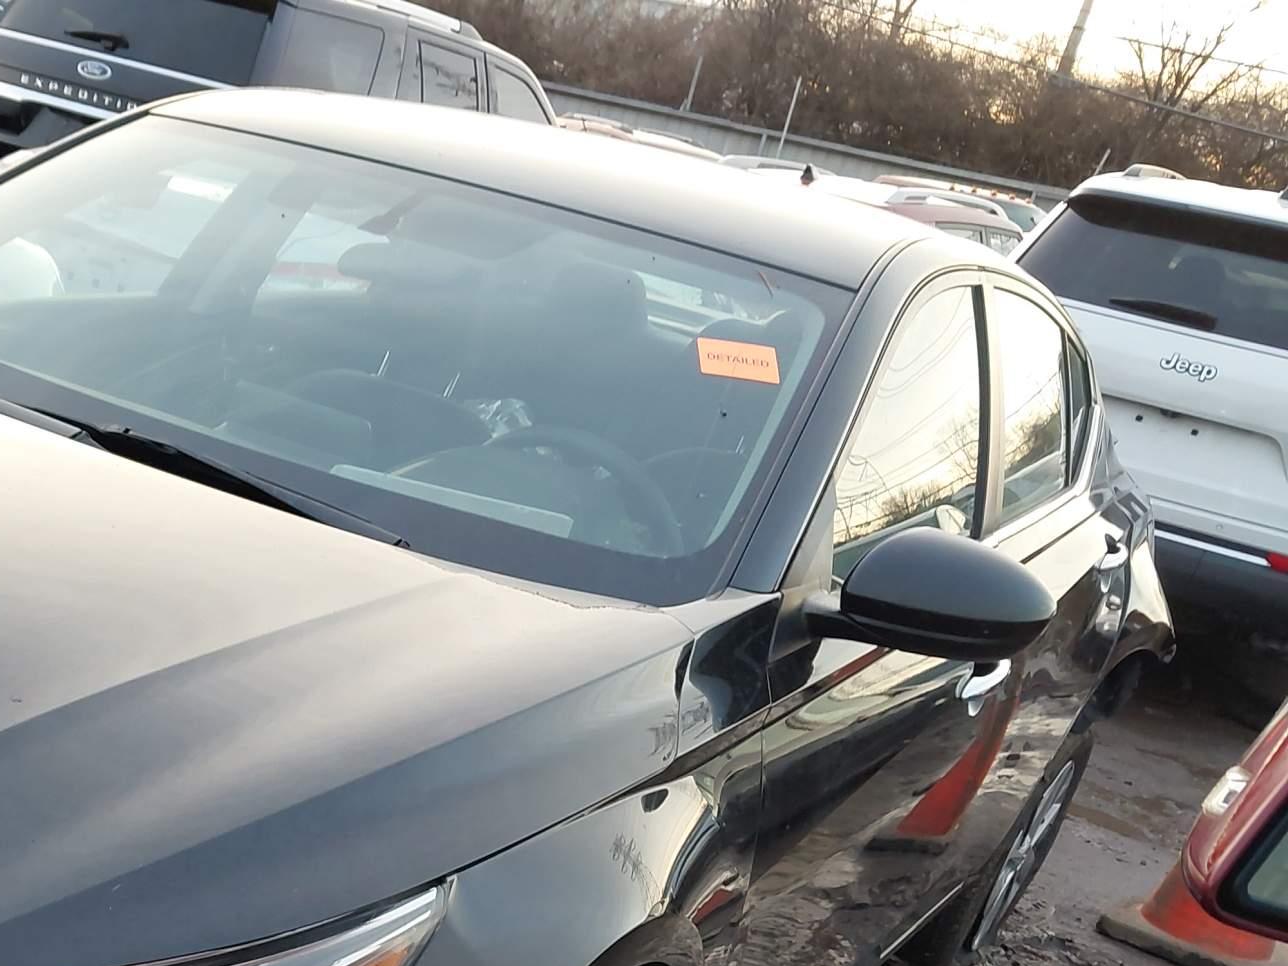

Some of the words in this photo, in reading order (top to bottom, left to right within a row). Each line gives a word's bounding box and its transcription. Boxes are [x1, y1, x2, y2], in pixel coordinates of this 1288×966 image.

[20, 72, 137, 112] EXPEDITIO
[706, 351, 770, 369] DETAILED
[1159, 352, 1218, 383] Jeep
